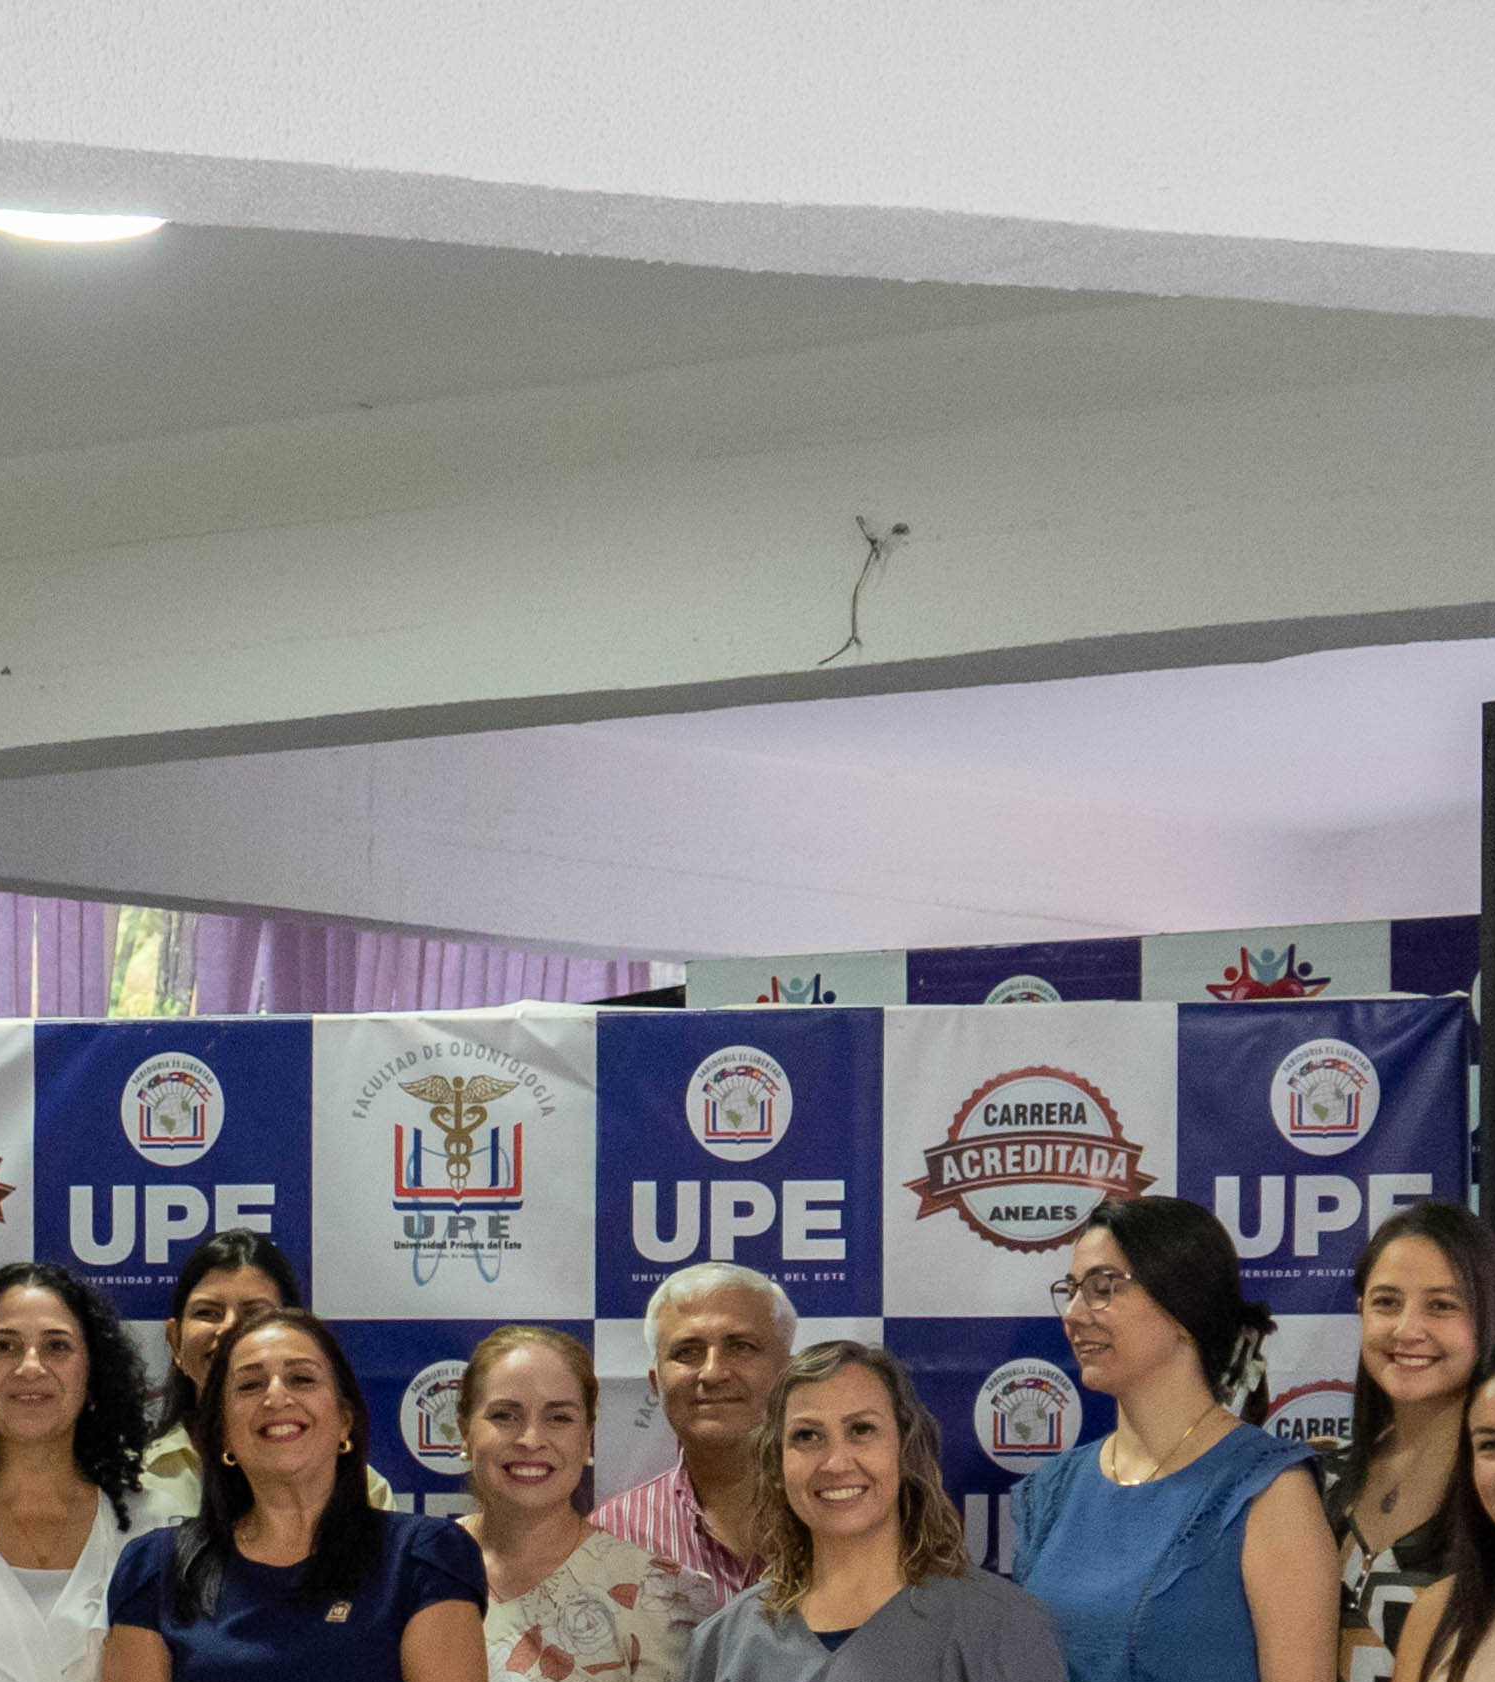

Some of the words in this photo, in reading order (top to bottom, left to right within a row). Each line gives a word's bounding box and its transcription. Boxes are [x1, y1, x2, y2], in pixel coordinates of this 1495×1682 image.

[352, 1051, 418, 1119] FACULTAD
[423, 1043, 443, 1060] DE
[983, 1102, 1087, 1127] CARRERA
[942, 1143, 1129, 1186] ACREDITADA
[632, 1180, 846, 1262] UPE
[989, 1205, 1077, 1222] ANEAES
[403, 1215, 510, 1239] UPE
[487, 1240, 501, 1250] del
[85, 1276, 152, 1285] VERSIDAD
[784, 1273, 808, 1282] DEL
[814, 1273, 846, 1281] ESTE
[1240, 1269, 1300, 1278] ERSIDAD
[1308, 1269, 1355, 1277] PRIVAD
[1276, 1417, 1352, 1441] CARRE
